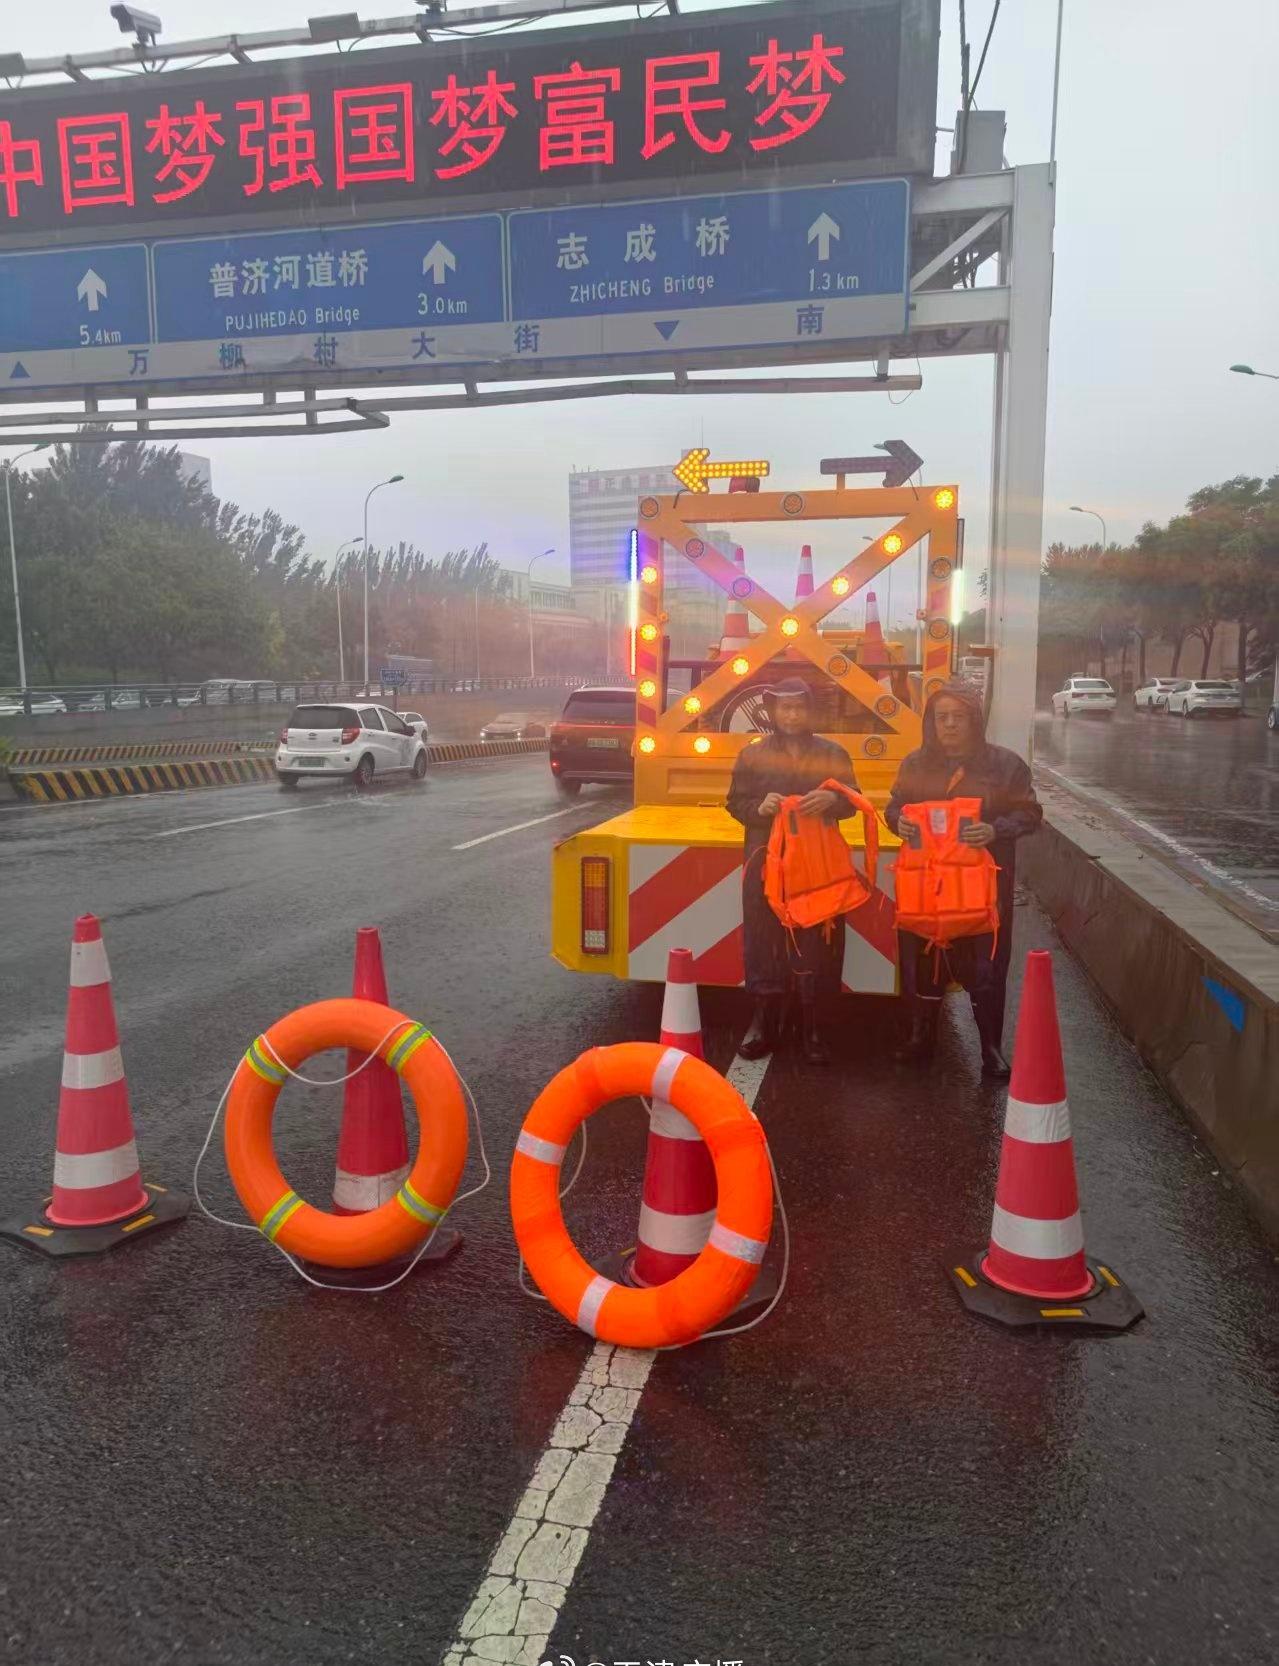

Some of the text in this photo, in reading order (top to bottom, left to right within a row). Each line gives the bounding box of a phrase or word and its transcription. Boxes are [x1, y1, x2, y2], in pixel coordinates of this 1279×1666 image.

[0, 33, 847, 217] 中国梦强国梦富民梦
[556, 216, 730, 270] 志成桥
[209, 248, 369, 298] 普济河道桥
[569, 273, 715, 303] ZHICHENG Bridge
[226, 306, 360, 331] PUJIHEDAO Bridge
[796, 305, 825, 335] 南
